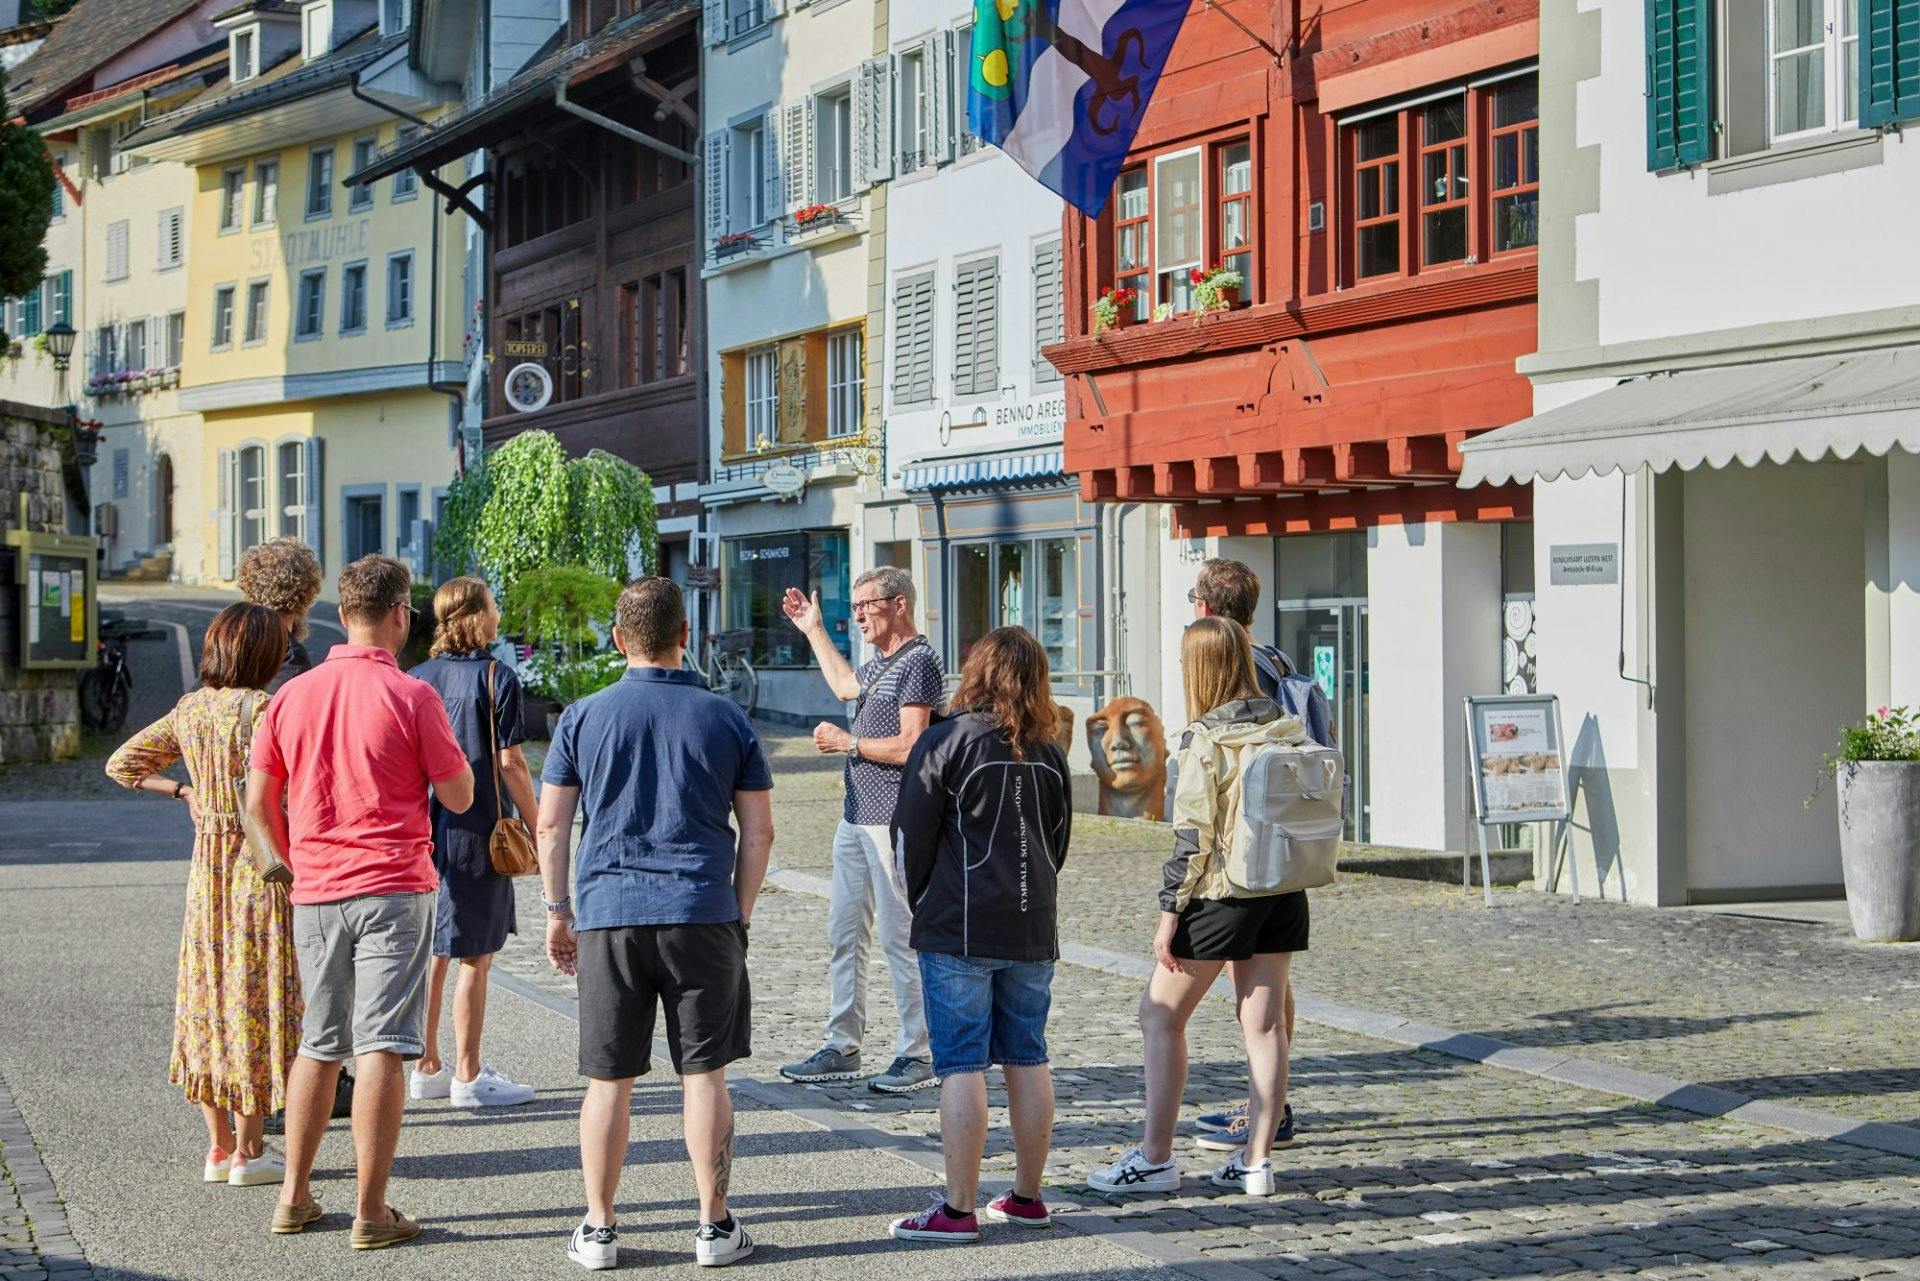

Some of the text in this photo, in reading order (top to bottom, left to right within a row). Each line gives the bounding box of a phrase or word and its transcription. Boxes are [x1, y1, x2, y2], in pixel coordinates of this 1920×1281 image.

[996, 404, 1034, 425] BENNO
[1018, 421, 1062, 437] IMMOBILIEN
[1583, 555, 1600, 563] LUZERN
[1600, 554, 1613, 563] WEST
[1019, 861, 1028, 912] CYMBALS
